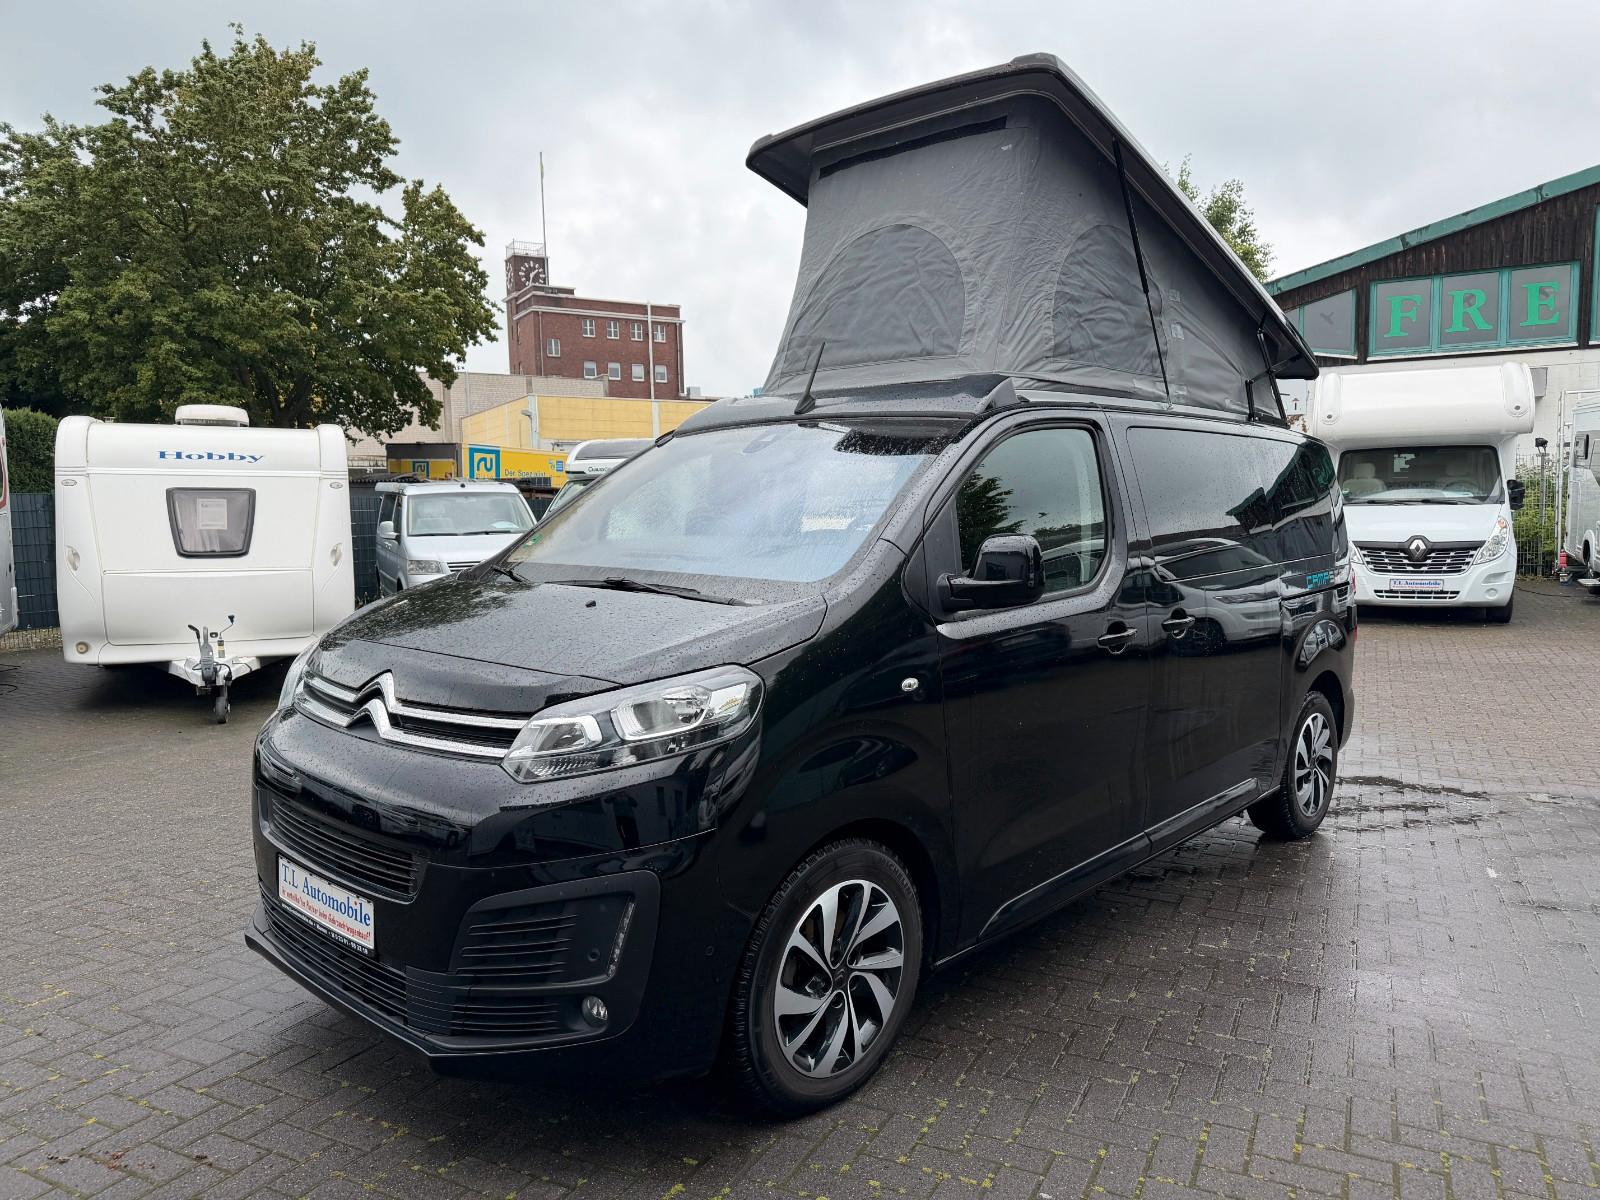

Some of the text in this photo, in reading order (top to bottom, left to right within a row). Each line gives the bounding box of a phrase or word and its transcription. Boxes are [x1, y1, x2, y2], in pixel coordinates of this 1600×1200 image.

[157, 450, 264, 463] Hobby
[504, 468, 515, 476] Der
[302, 877, 371, 927] Automobile
